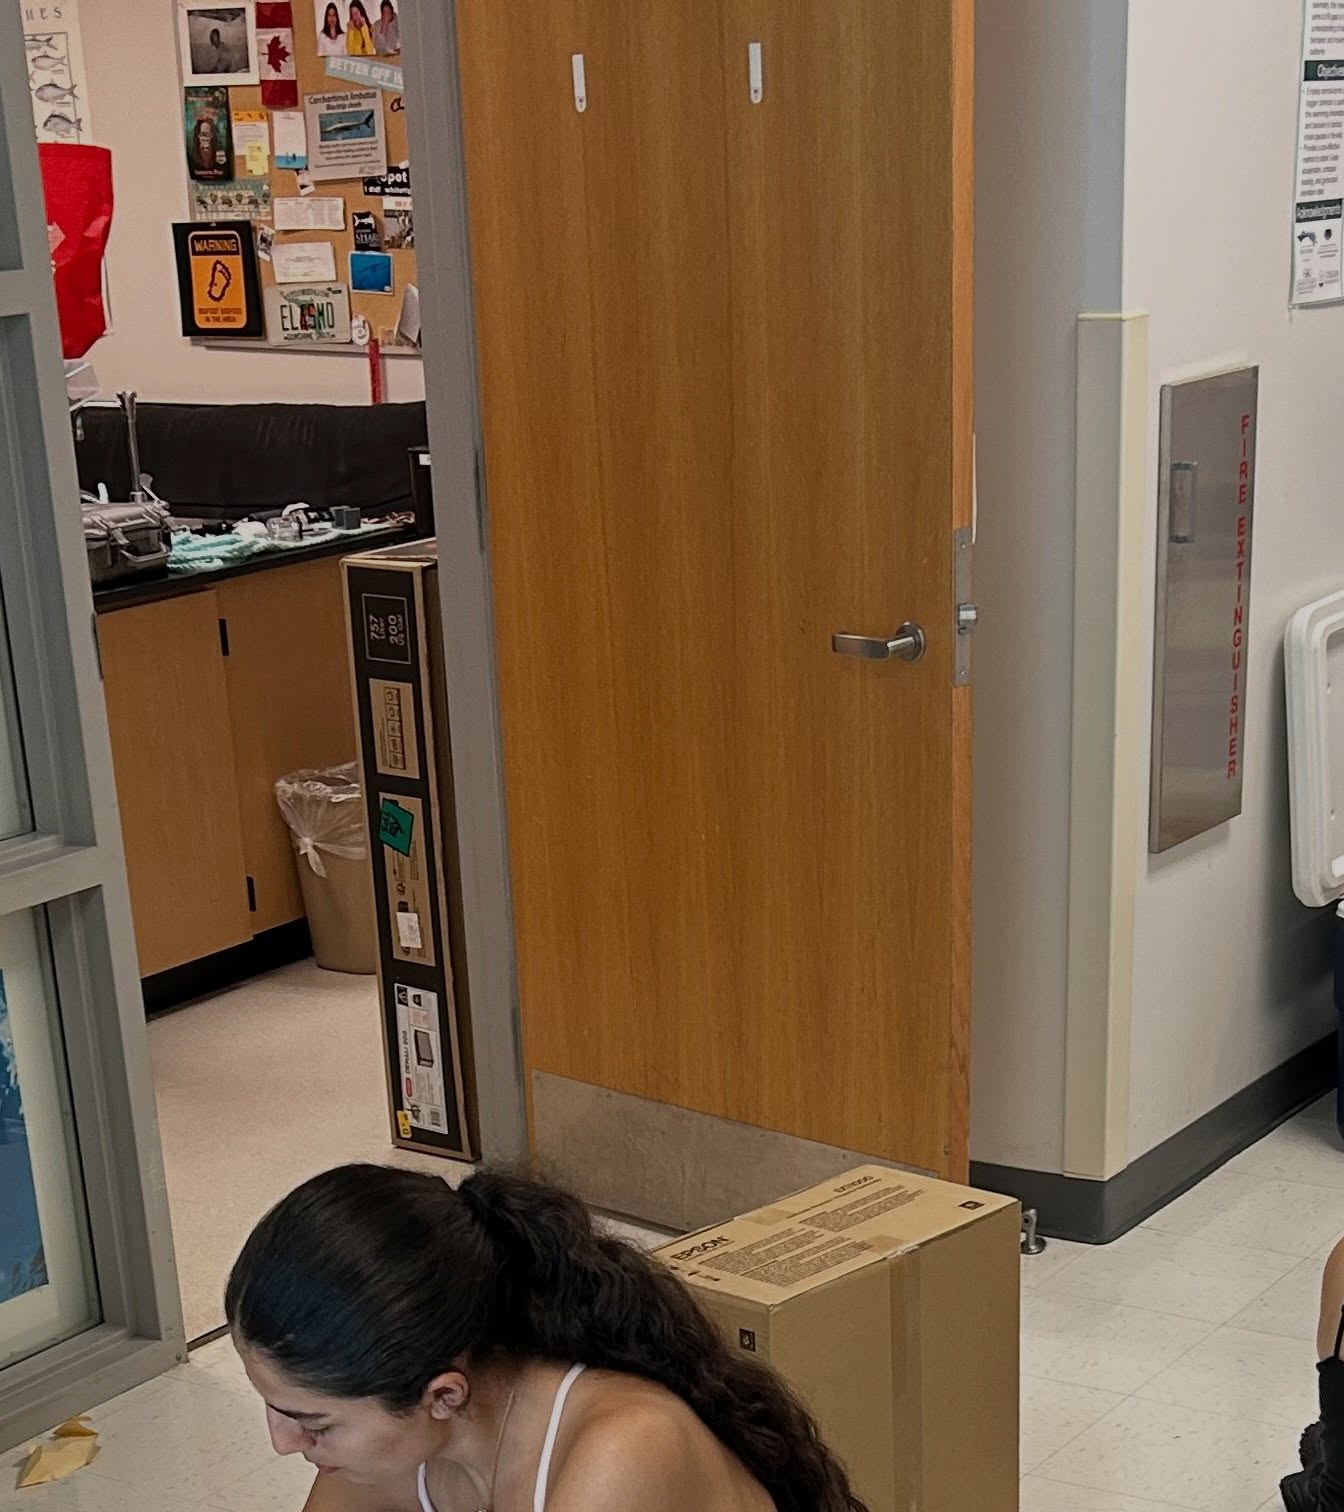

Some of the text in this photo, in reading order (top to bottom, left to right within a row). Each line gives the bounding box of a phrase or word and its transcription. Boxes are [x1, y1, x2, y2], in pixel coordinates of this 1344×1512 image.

[193, 239, 238, 252] WARNING
[1238, 415, 1250, 504] FIRE
[369, 614, 380, 640] 757
[387, 615, 399, 645] 200
[1226, 520, 1246, 780] EXTINGUISHER
[670, 1235, 731, 1262] EPSON
